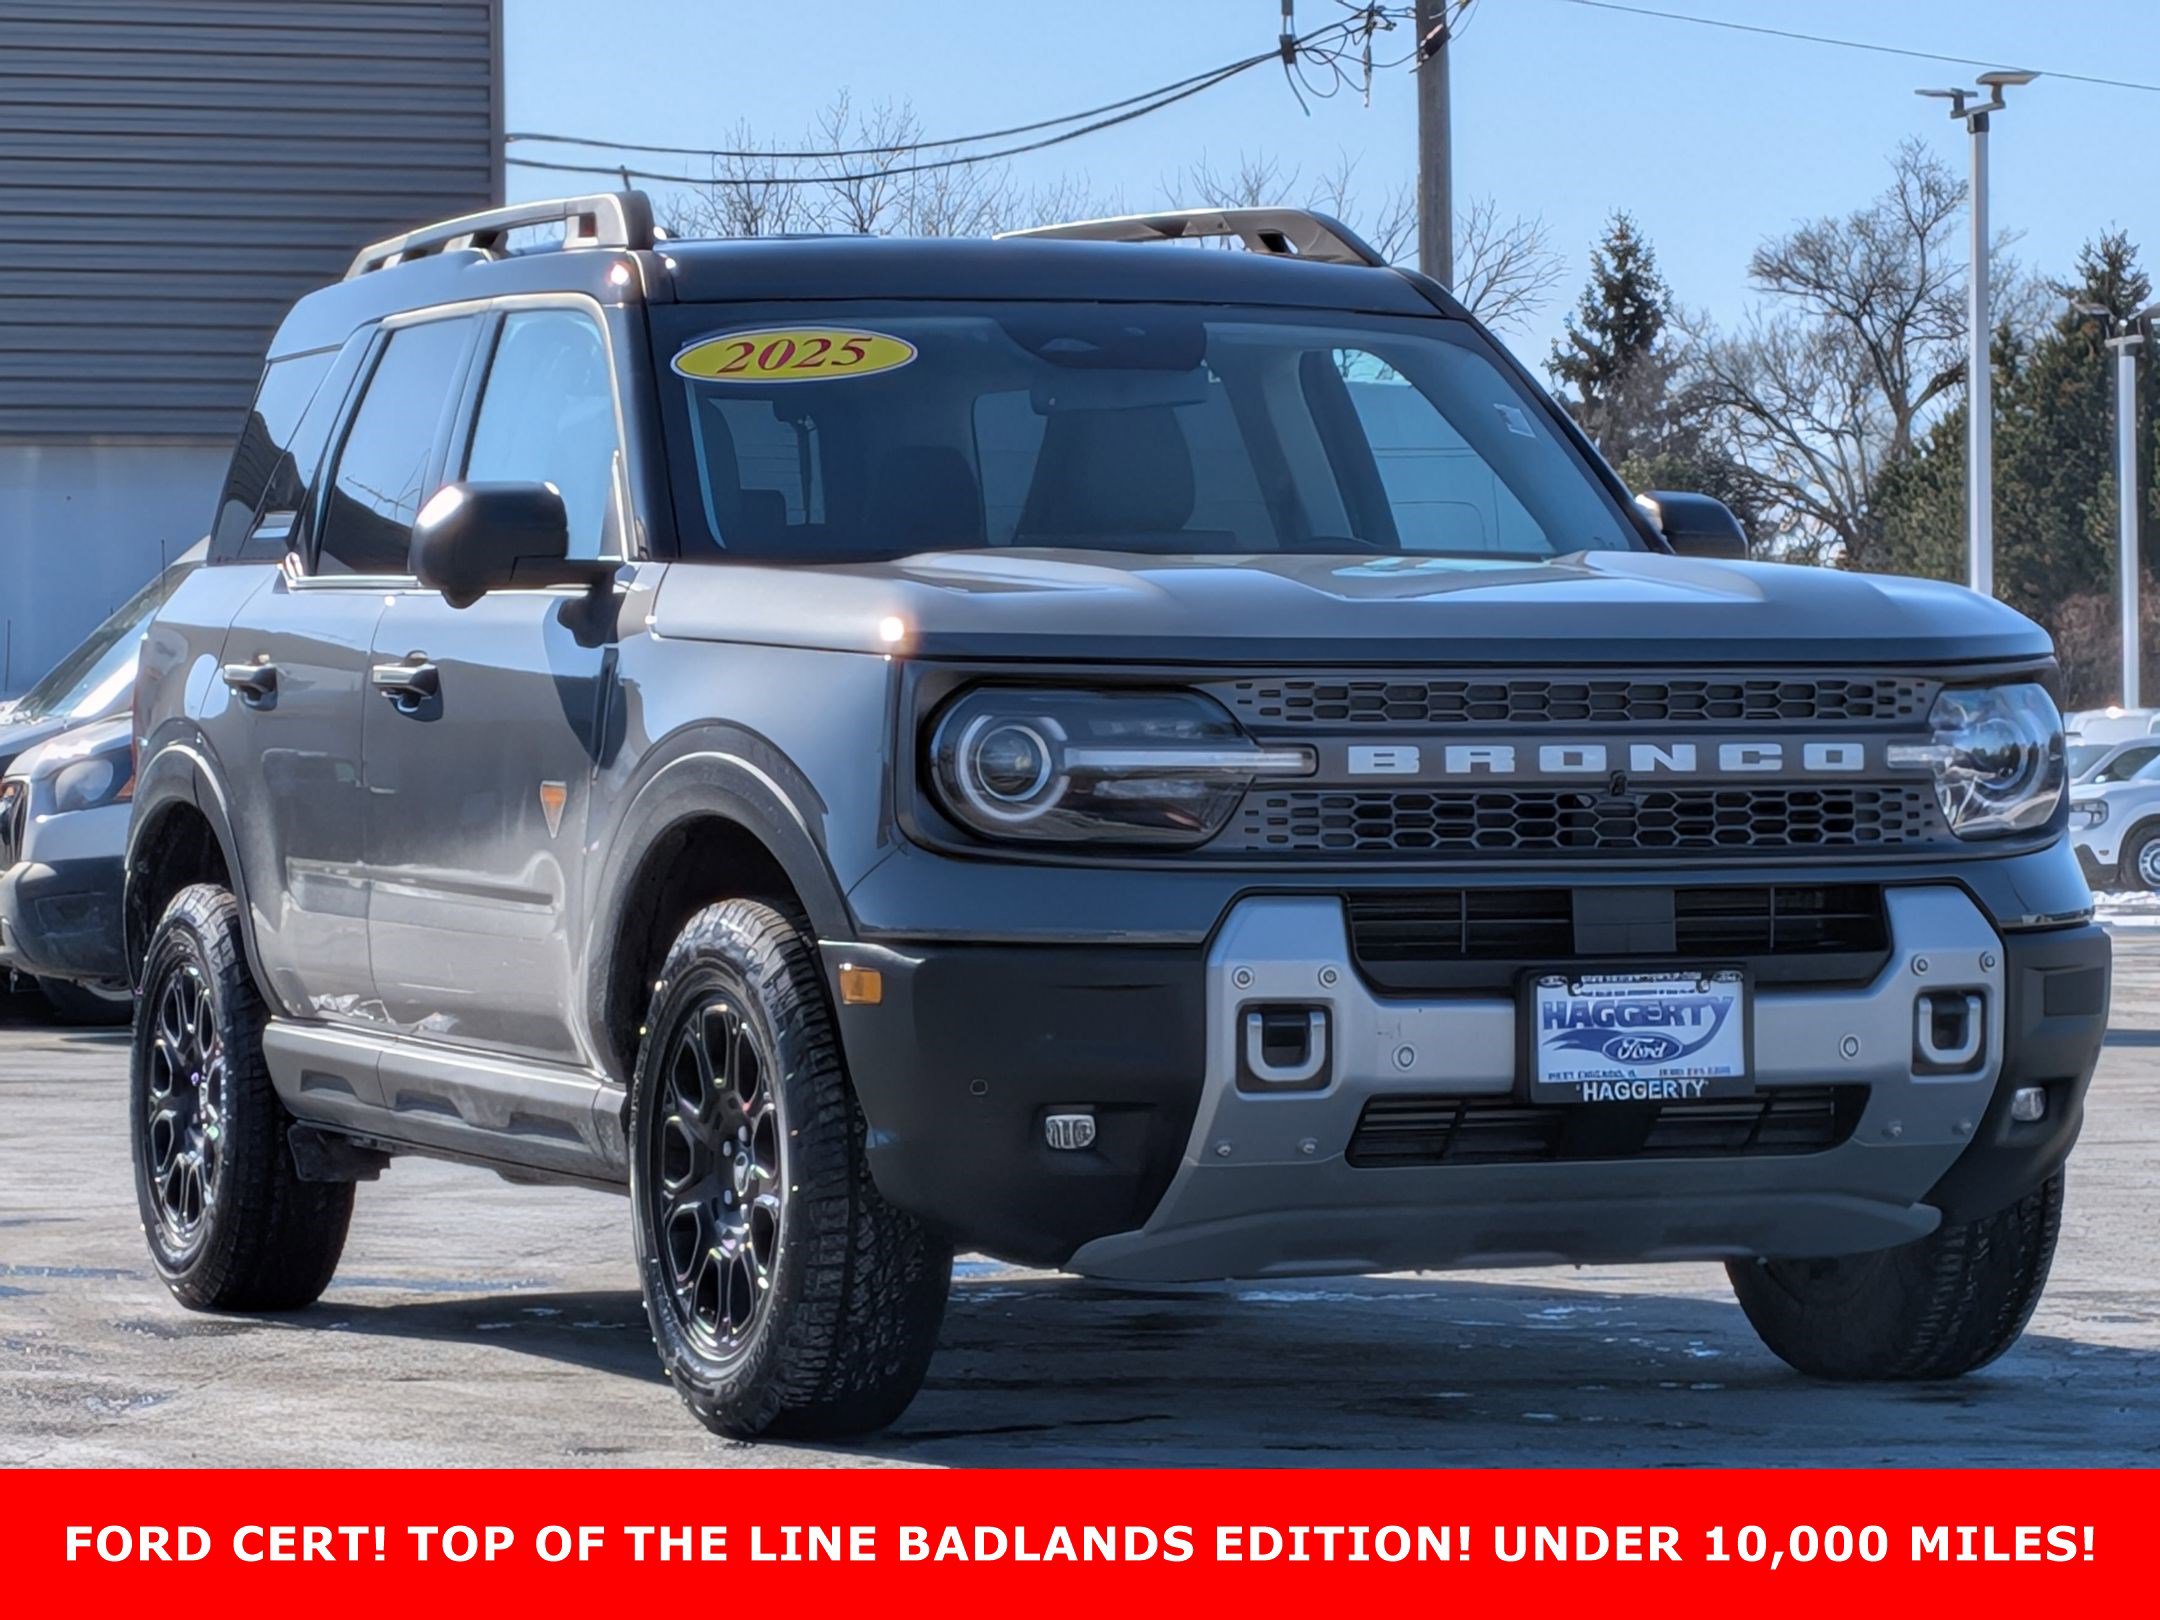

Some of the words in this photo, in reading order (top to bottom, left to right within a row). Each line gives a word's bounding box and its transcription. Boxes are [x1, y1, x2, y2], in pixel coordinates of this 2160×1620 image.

[716, 337, 873, 374] 2025
[1347, 743, 1865, 775] BRONCO
[1542, 996, 1736, 1031] HAGGERTY
[1616, 1037, 1668, 1060] Ford
[1581, 1079, 1705, 1102] HAGGERTY
